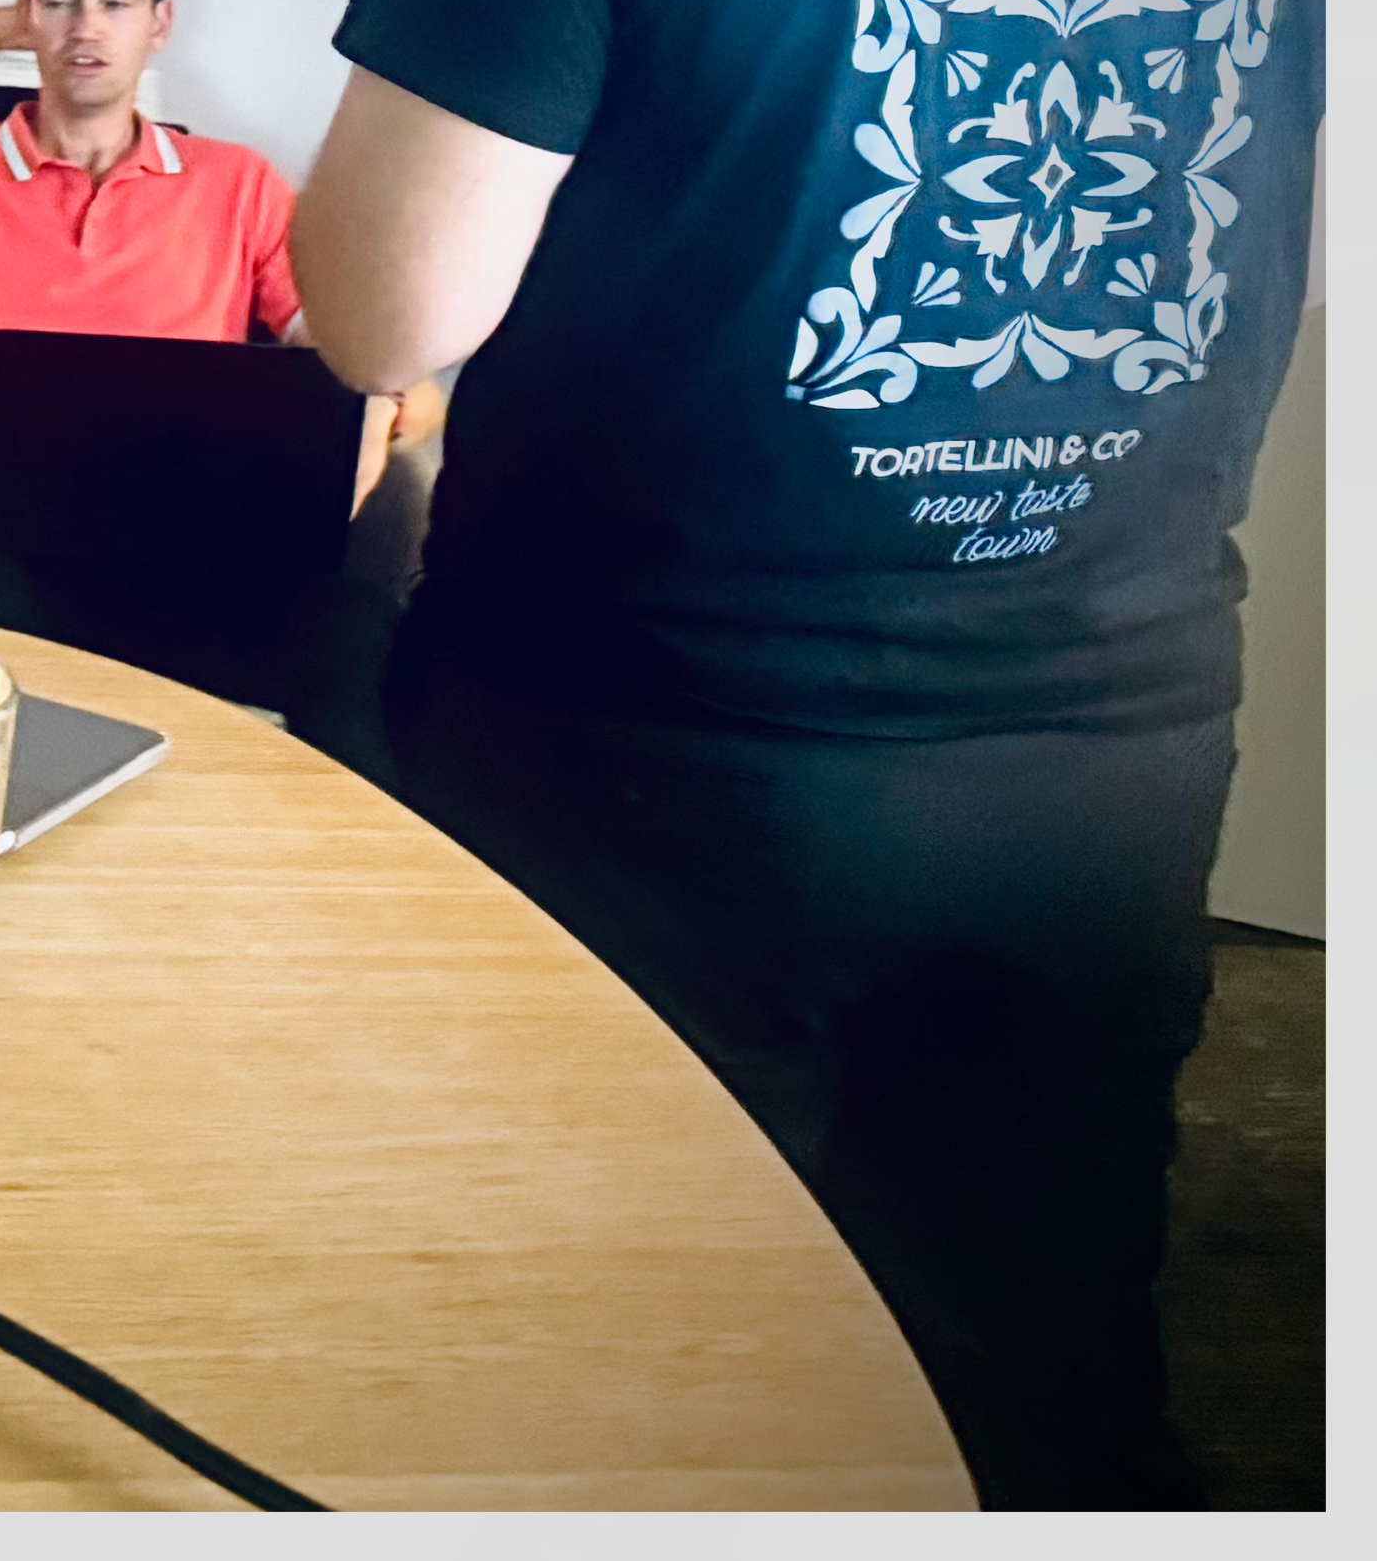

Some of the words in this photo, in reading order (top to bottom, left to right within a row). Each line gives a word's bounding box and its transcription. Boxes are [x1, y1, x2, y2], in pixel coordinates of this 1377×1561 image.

[851, 436, 1054, 478] TORTELLINI
[1058, 434, 1087, 466] &
[1092, 428, 1143, 461] CO
[910, 491, 1005, 525] new
[1011, 472, 1095, 522] taste
[952, 525, 1059, 564] town
